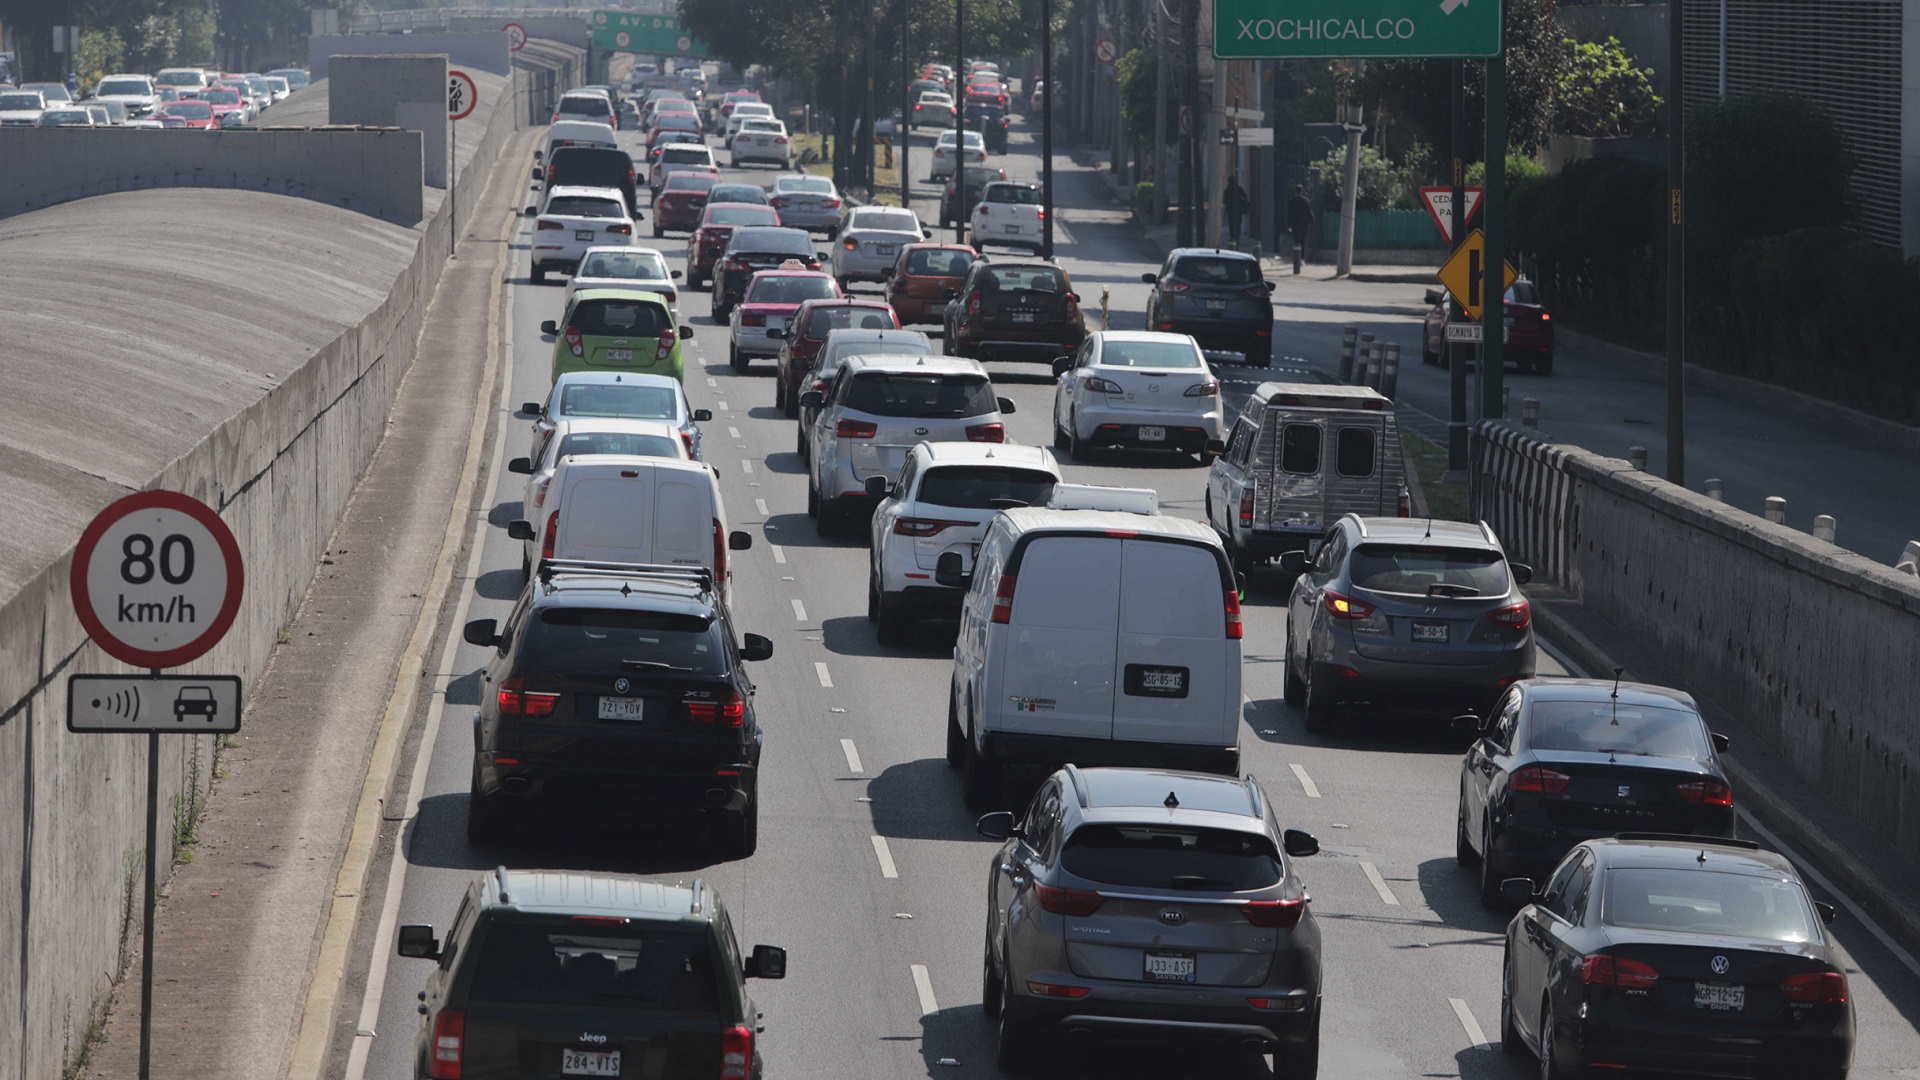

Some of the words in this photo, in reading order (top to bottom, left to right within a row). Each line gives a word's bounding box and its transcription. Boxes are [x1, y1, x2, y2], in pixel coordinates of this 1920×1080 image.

[1237, 18, 1415, 41] XOCHICALCO
[1439, 208, 1453, 217] PA
[120, 533, 195, 585] 80
[118, 593, 196, 624] km/h
[602, 702, 641, 714] 721-YDV
[1592, 806, 1655, 817] TOLEDO
[1164, 912, 1181, 920] KIA
[1625, 988, 1648, 996] JETTA
[580, 1031, 607, 1044] Jeep
[565, 1055, 619, 1072] 284-VTS
